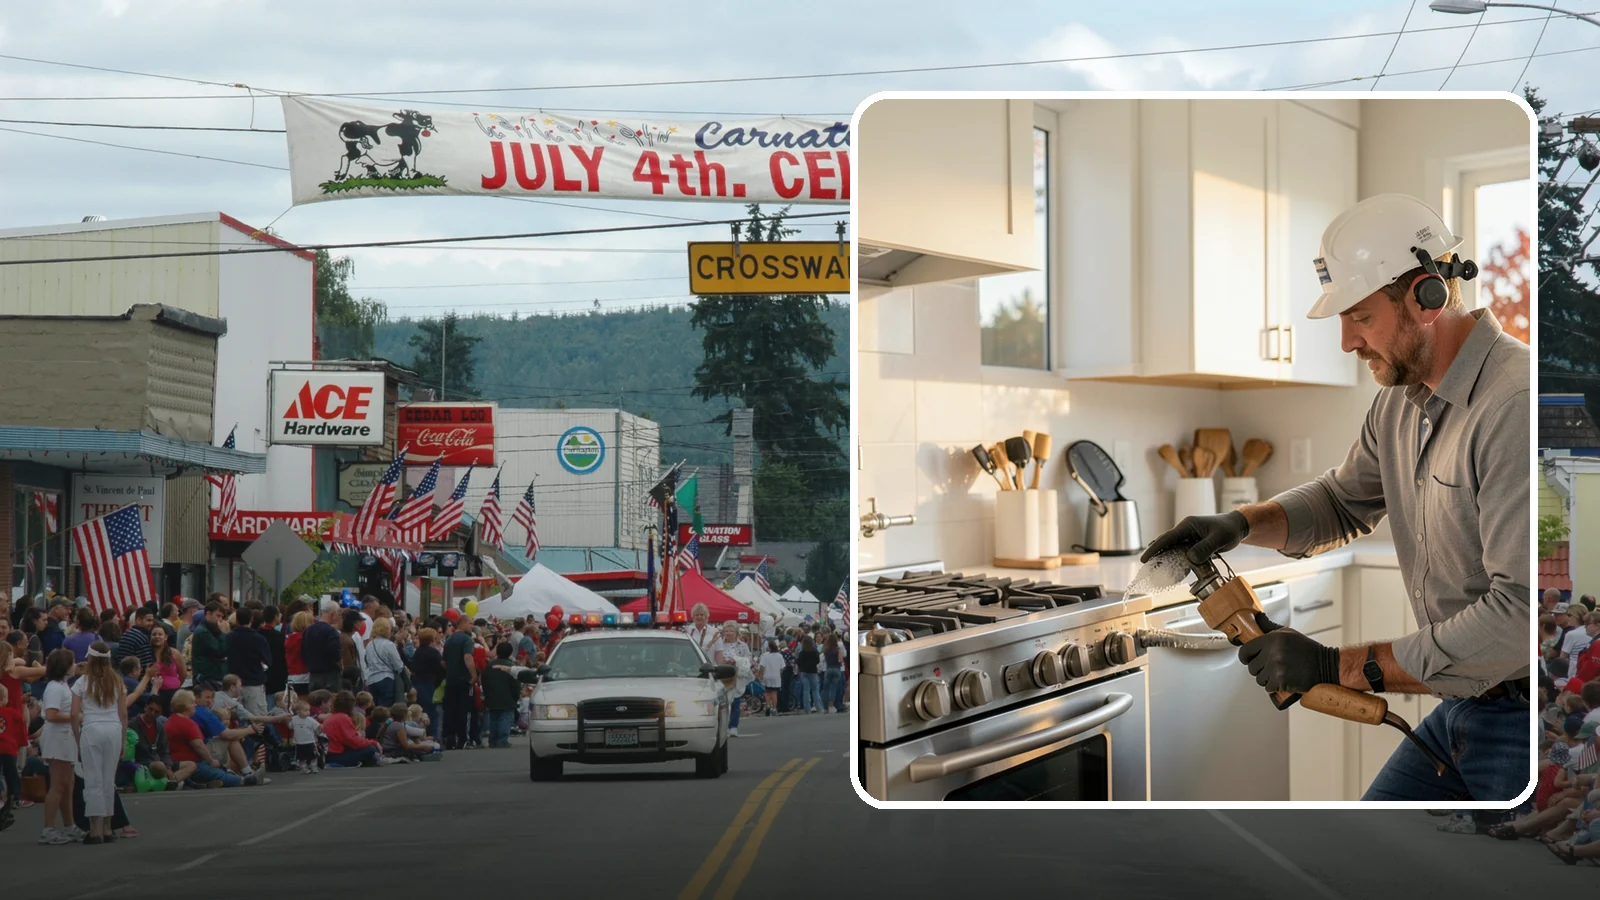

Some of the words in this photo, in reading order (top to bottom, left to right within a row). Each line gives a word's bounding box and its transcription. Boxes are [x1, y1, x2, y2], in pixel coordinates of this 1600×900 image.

[481, 141, 604, 192] JULY
[632, 150, 746, 198] 4th.
[697, 254, 850, 280] CROSSWA
[283, 380, 373, 420] ACE
[406, 409, 452, 421] CEDAR
[284, 421, 371, 436] Hardware
[353, 467, 385, 481] Simpl
[95, 485, 124, 495] Vincent
[126, 485, 136, 495] de
[138, 486, 155, 495] Paul
[213, 516, 331, 535] HARDARE
[688, 526, 741, 535] CRNATION
[699, 535, 730, 543] GLASS
